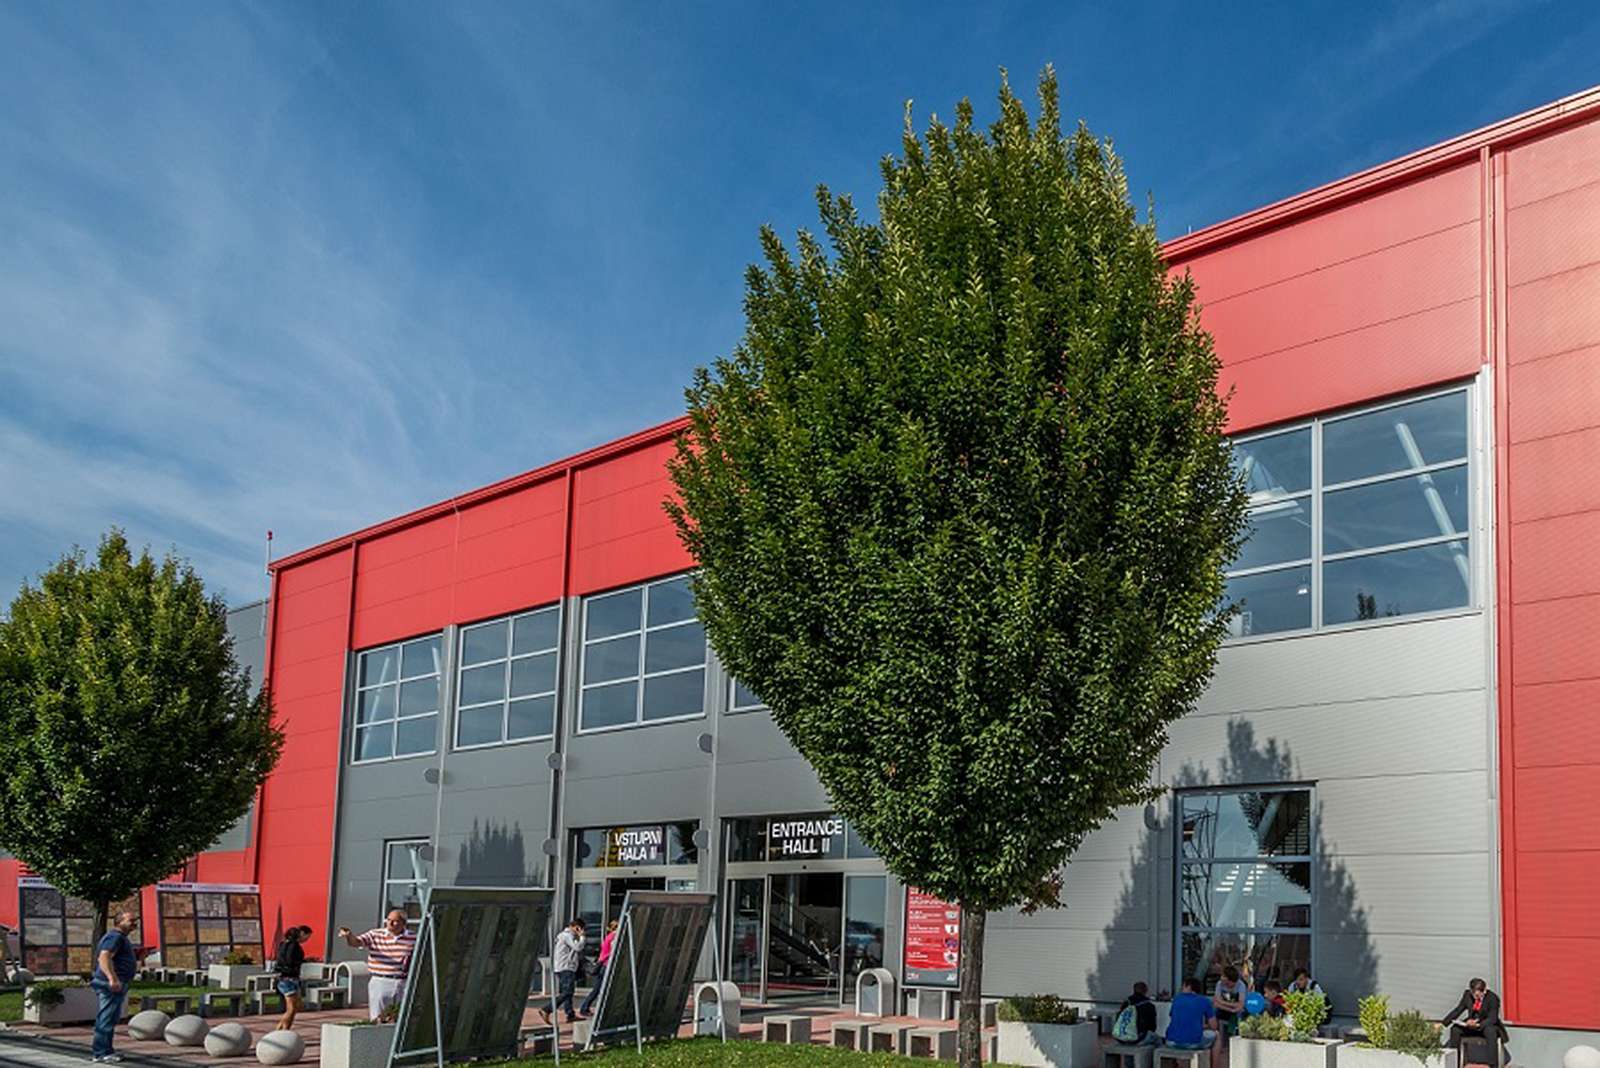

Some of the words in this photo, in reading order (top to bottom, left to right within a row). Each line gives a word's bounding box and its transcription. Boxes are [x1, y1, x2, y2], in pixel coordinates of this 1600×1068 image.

[772, 820, 843, 838] ENTRANCE
[618, 846, 648, 861] HALA
[650, 846, 658, 860] II
[782, 838, 818, 855] HALL
[821, 838, 830, 854] II
